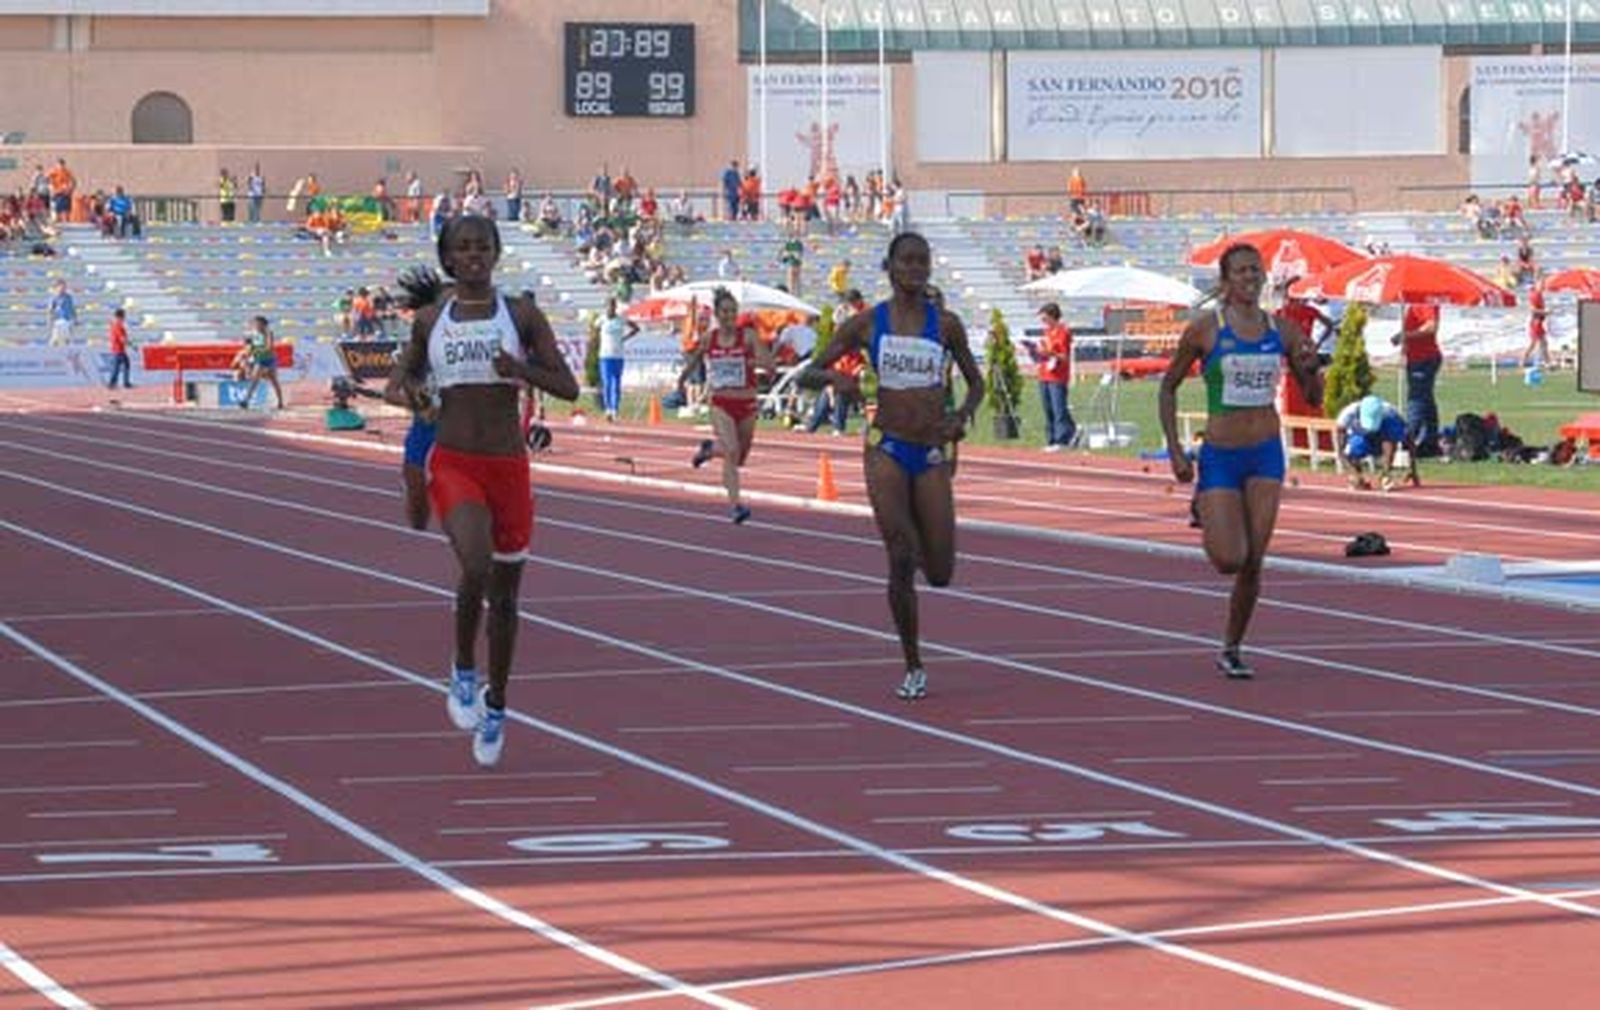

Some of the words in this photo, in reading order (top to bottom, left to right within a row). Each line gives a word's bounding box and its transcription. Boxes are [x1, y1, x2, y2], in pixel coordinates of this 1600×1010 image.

[1320, 5, 1402, 20] SAN
[1027, 77, 1063, 92] SAN
[1067, 76, 1166, 92] FERNANDO
[1170, 76, 1242, 99] 2010
[575, 102, 613, 114] LOCAL
[882, 352, 935, 375] PADILLA
[945, 821, 1187, 842] 5
[507, 833, 736, 851] 6
